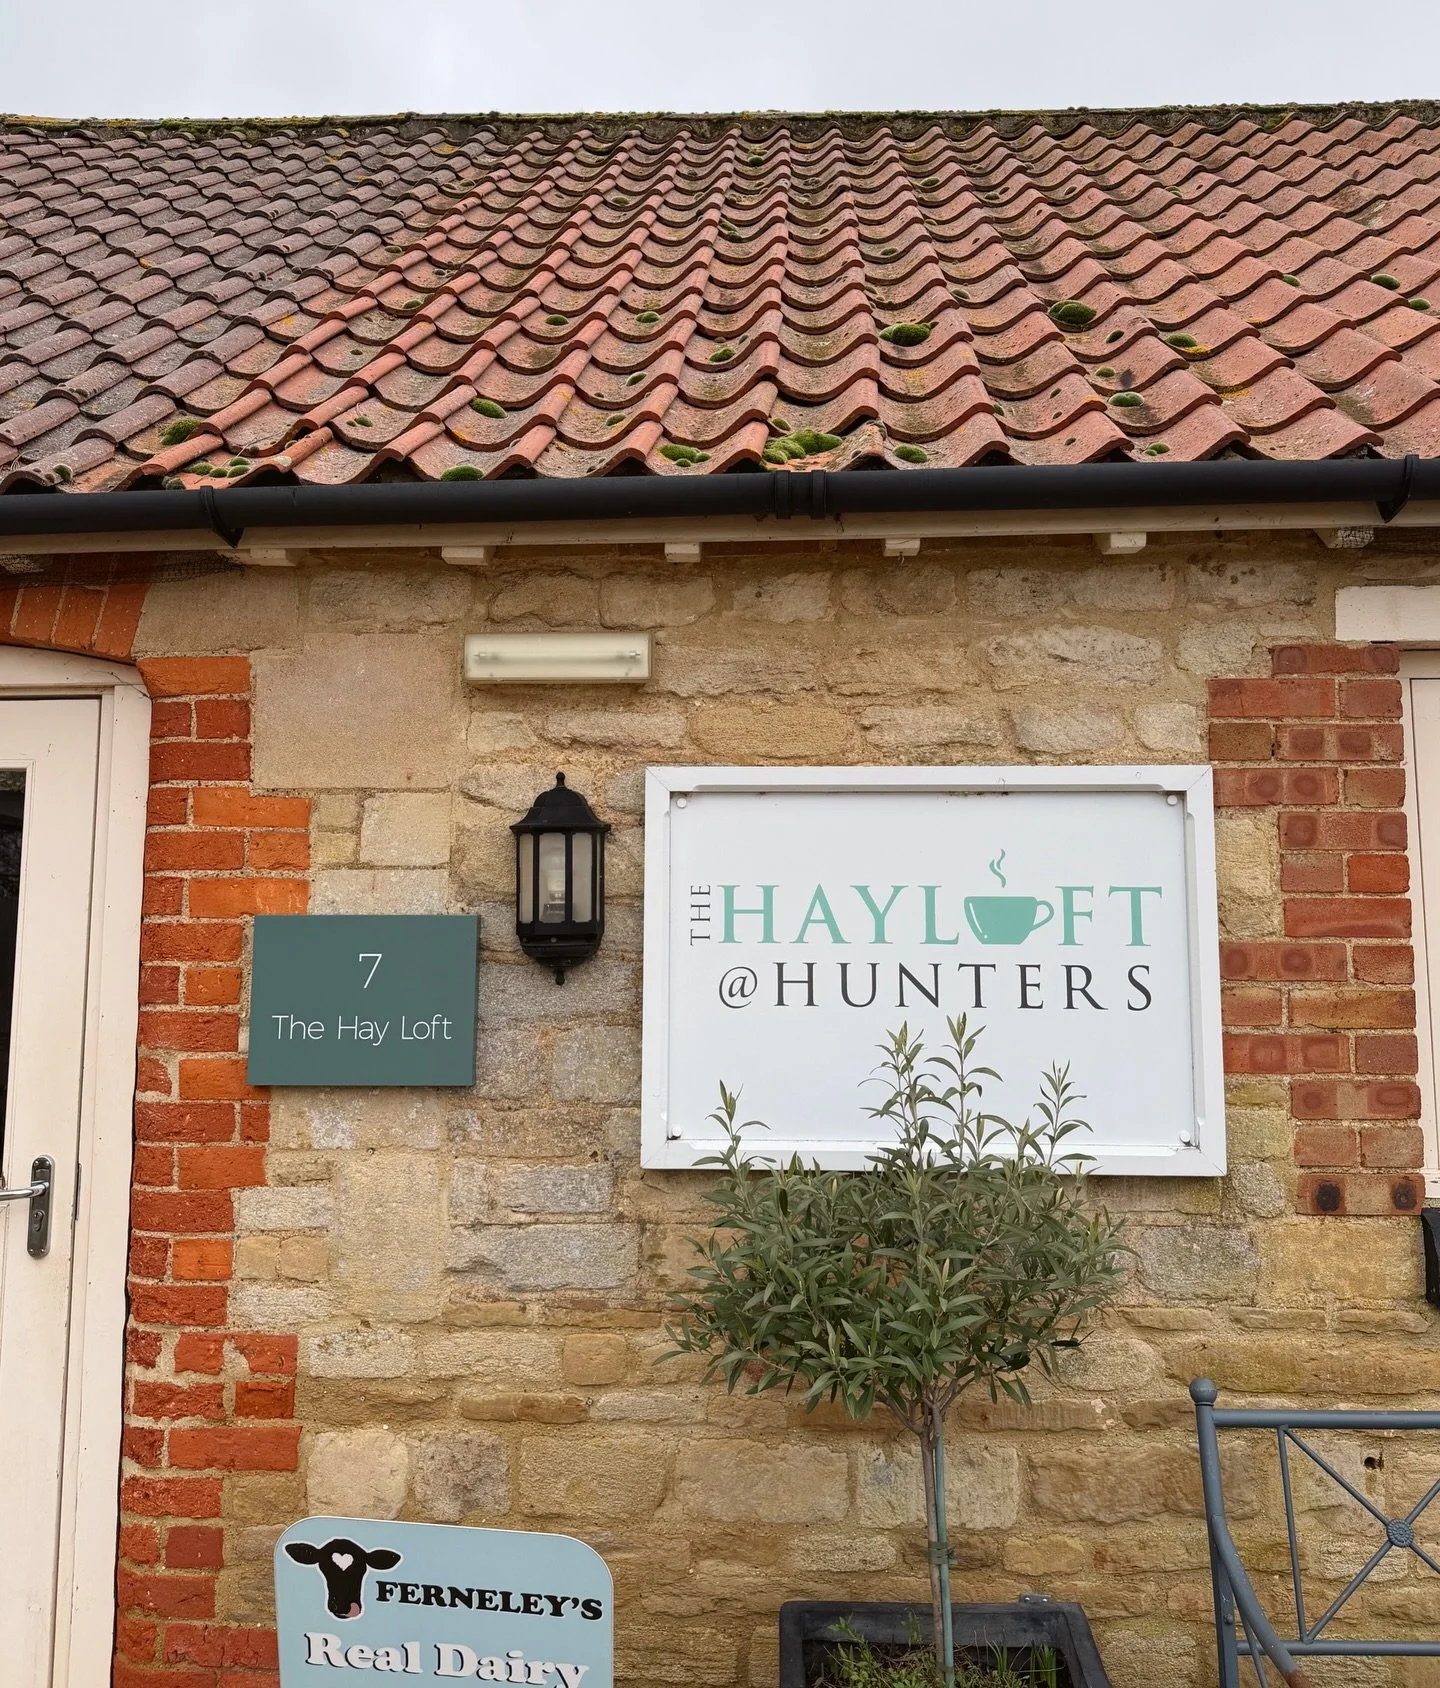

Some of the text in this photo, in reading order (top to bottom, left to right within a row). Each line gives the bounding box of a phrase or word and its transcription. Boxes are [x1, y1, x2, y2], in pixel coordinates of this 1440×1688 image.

[690, 883, 711, 947] THE
[358, 953, 383, 989] 7
[271, 1013, 453, 1046] The Hay Loft
[375, 1579, 604, 1621] FERNELEY'S
[304, 1631, 590, 1688] Real Dairy
